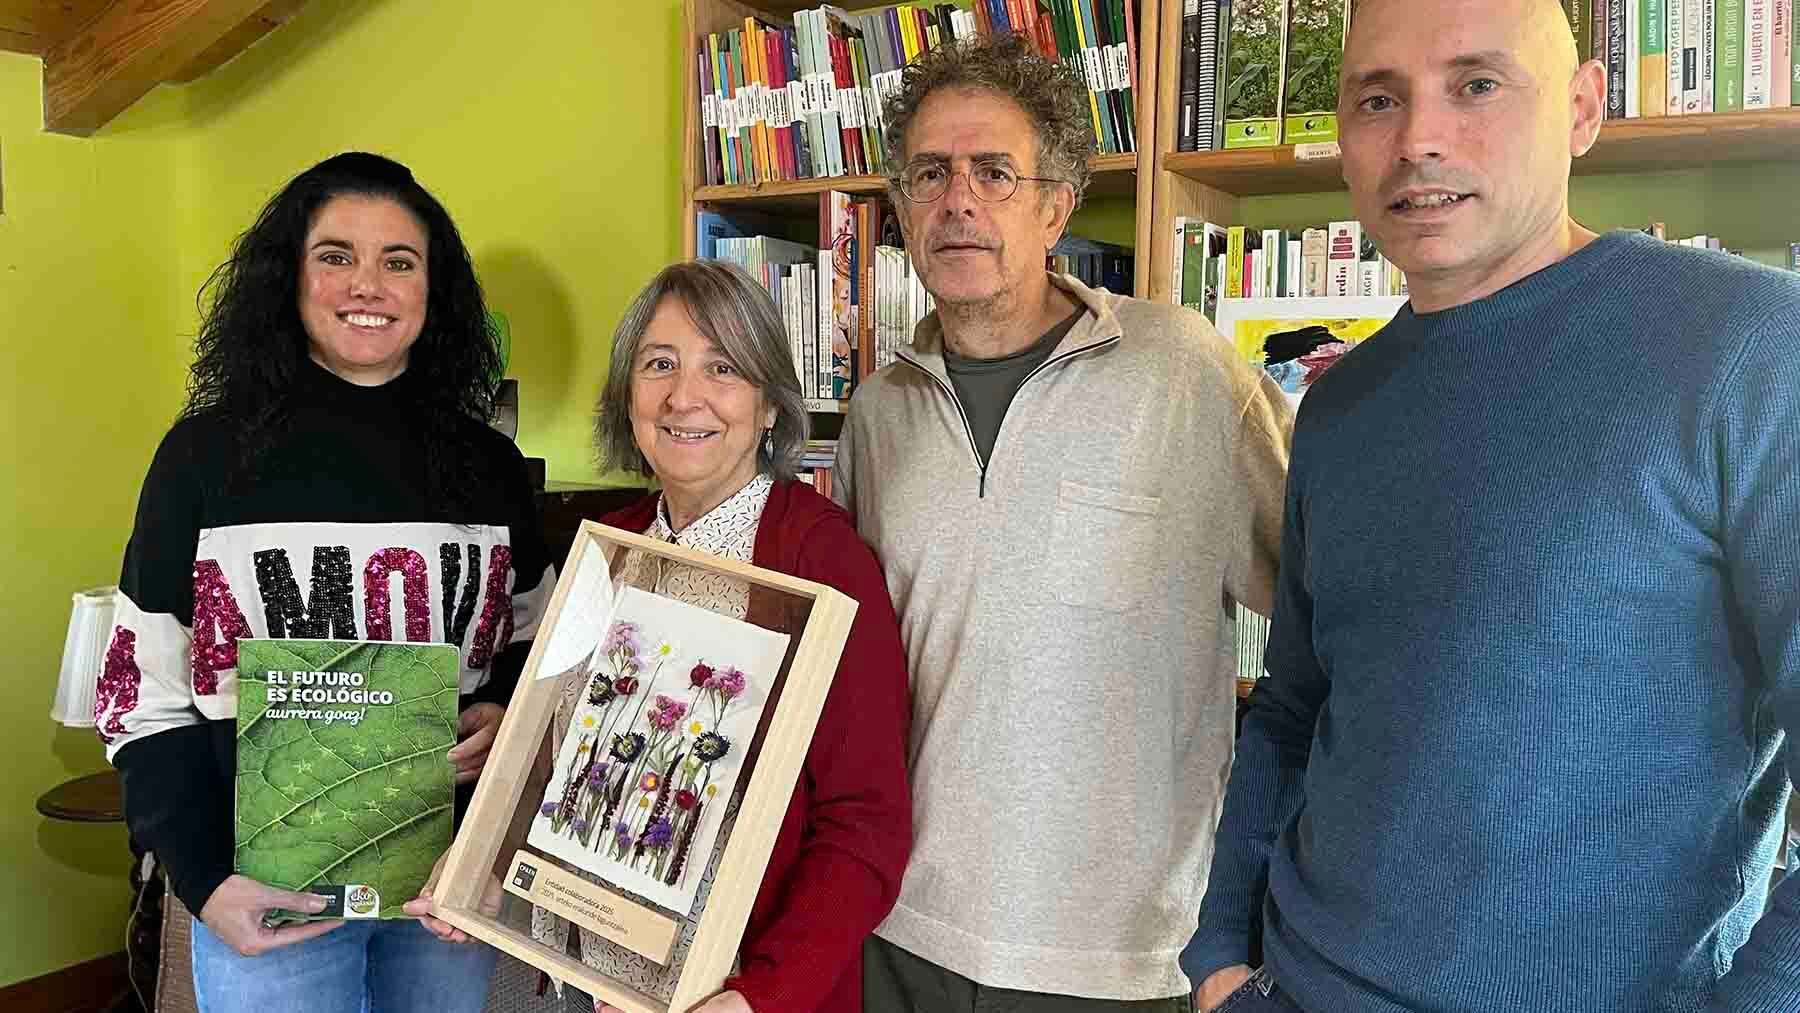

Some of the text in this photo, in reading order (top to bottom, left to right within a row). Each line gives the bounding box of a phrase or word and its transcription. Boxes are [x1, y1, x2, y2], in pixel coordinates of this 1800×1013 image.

[267, 671, 364, 686] EL FUTURO
[267, 687, 393, 704] ES ECOLÓGICO
[266, 708, 323, 719] aurrera
[544, 878, 566, 892] Entidad
[565, 888, 599, 908] colaboradora
